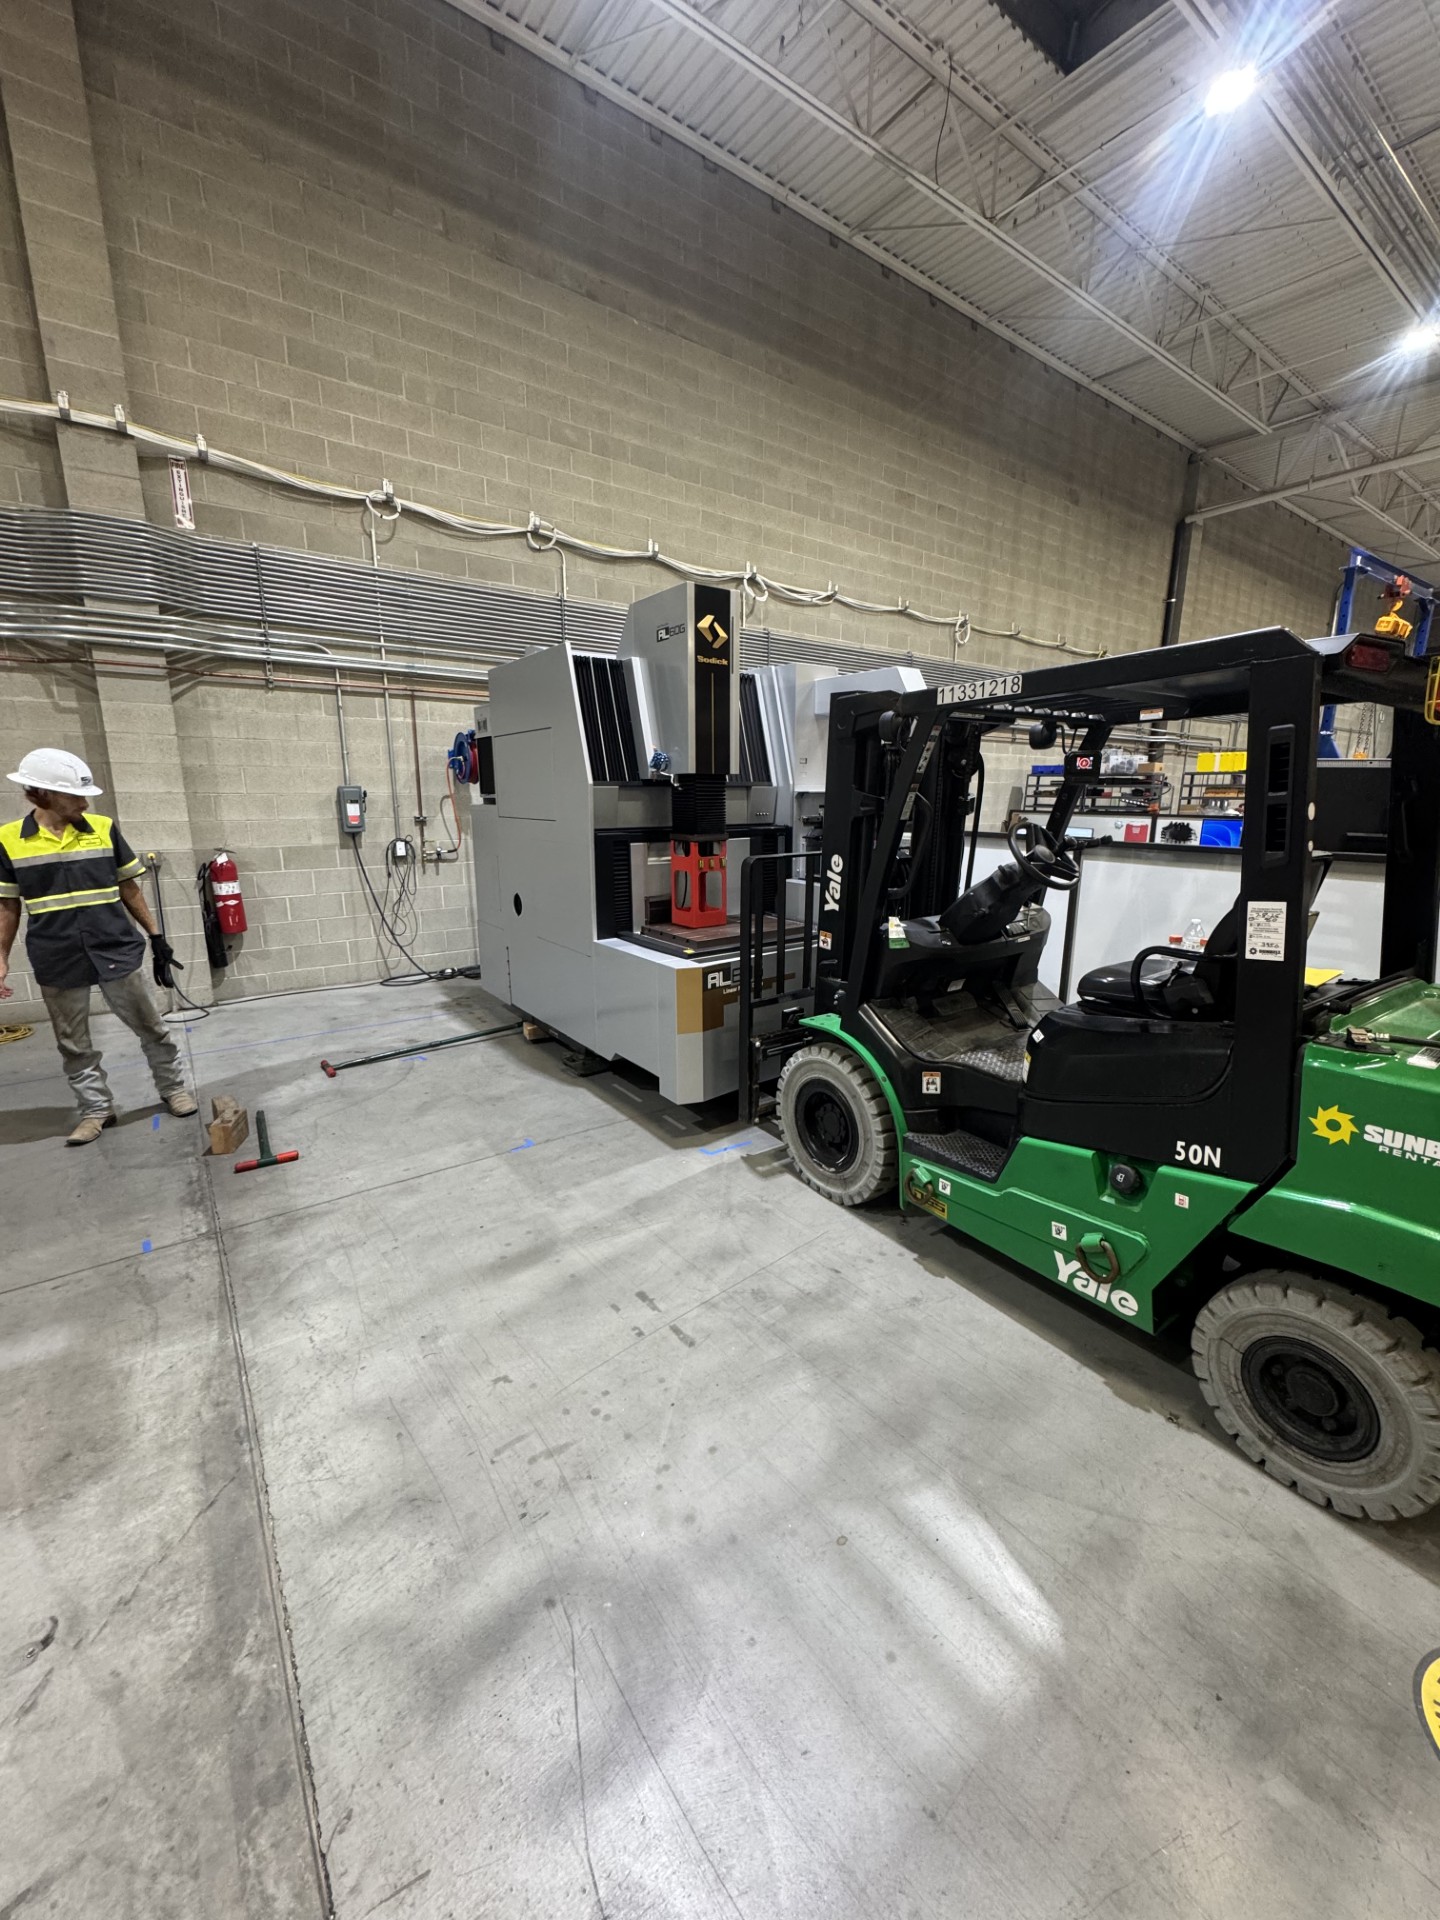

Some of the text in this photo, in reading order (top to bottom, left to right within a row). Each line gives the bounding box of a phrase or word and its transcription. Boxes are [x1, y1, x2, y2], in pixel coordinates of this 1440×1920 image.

[697, 654, 729, 666] Sodick
[939, 676, 1021, 704] 11331218
[824, 854, 844, 912] Yale
[1174, 1140, 1221, 1169] 50N
[1053, 1250, 1139, 1316] Yale
